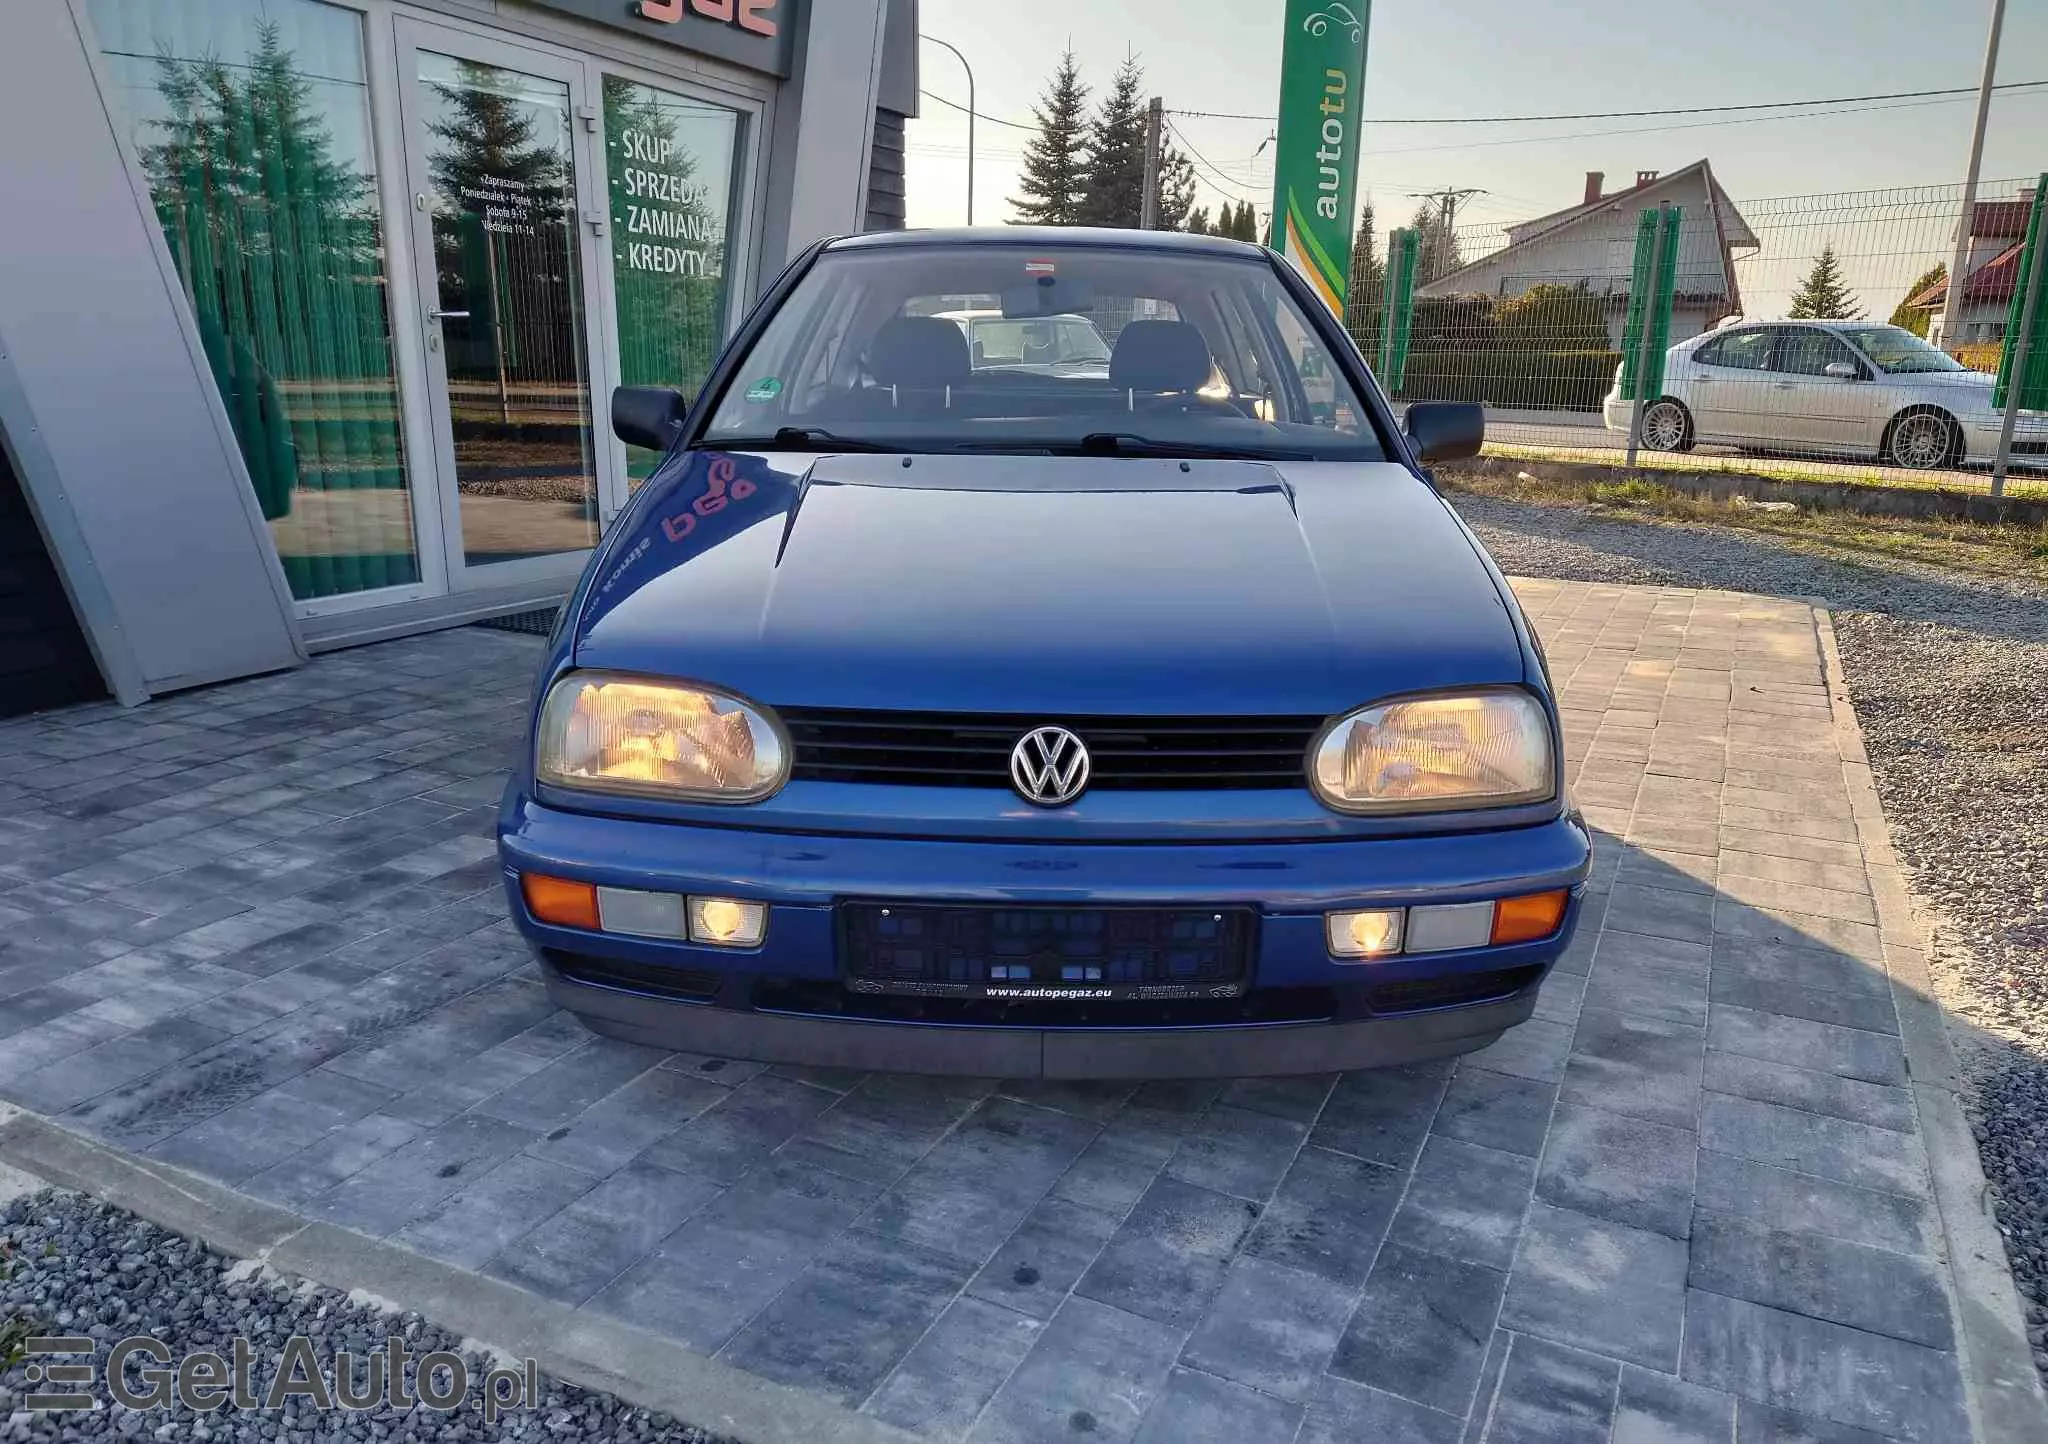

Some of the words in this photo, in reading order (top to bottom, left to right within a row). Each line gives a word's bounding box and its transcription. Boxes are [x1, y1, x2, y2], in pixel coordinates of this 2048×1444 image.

[622, 128, 670, 164] SKUP
[1315, 68, 1347, 219] autotu
[626, 204, 711, 241] ZAMIANA
[628, 242, 707, 277] KREDYTY
[986, 986, 1112, 999] www.autopegaz.eu
